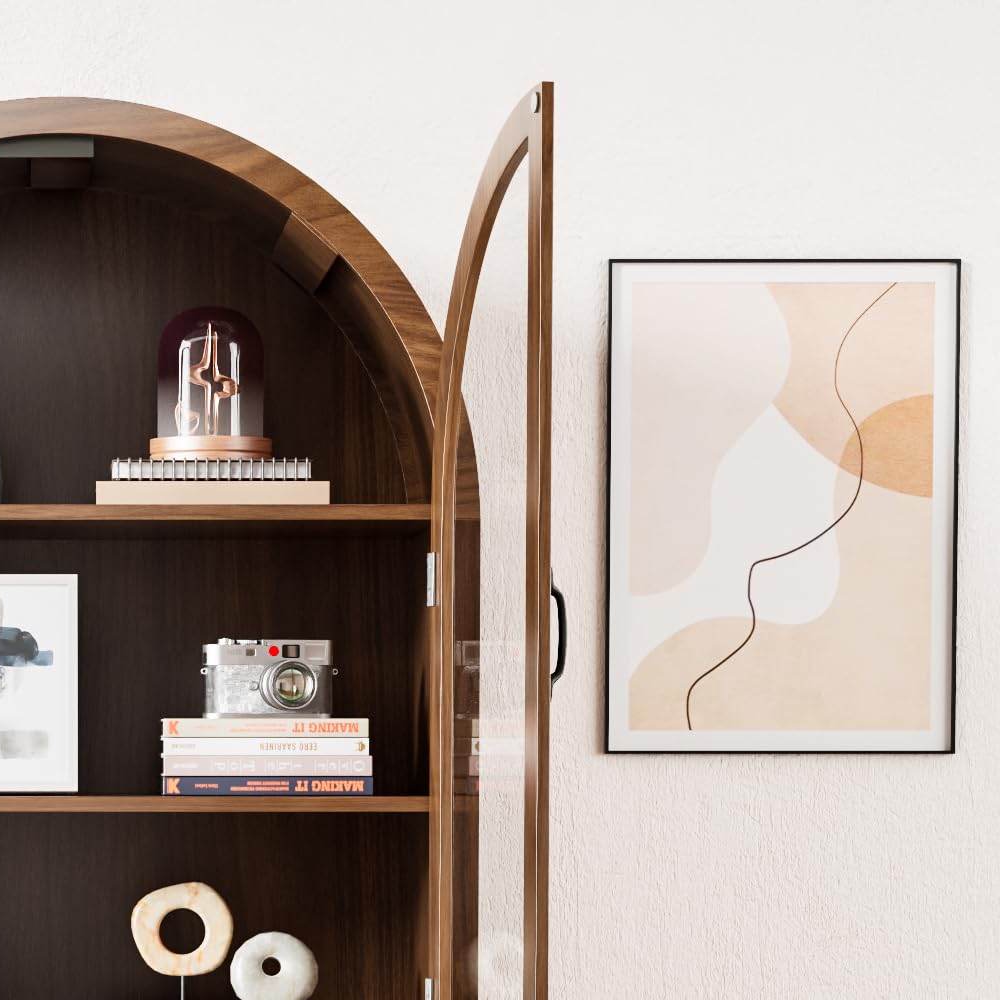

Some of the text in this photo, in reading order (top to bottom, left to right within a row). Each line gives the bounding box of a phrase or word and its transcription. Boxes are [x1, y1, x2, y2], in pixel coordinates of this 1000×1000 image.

[292, 722, 305, 733] IT
[308, 722, 359, 733] MAKING
[259, 742, 318, 751] EERO SAARINEN
[295, 780, 309, 792] IT
[311, 780, 364, 792] MAKING
